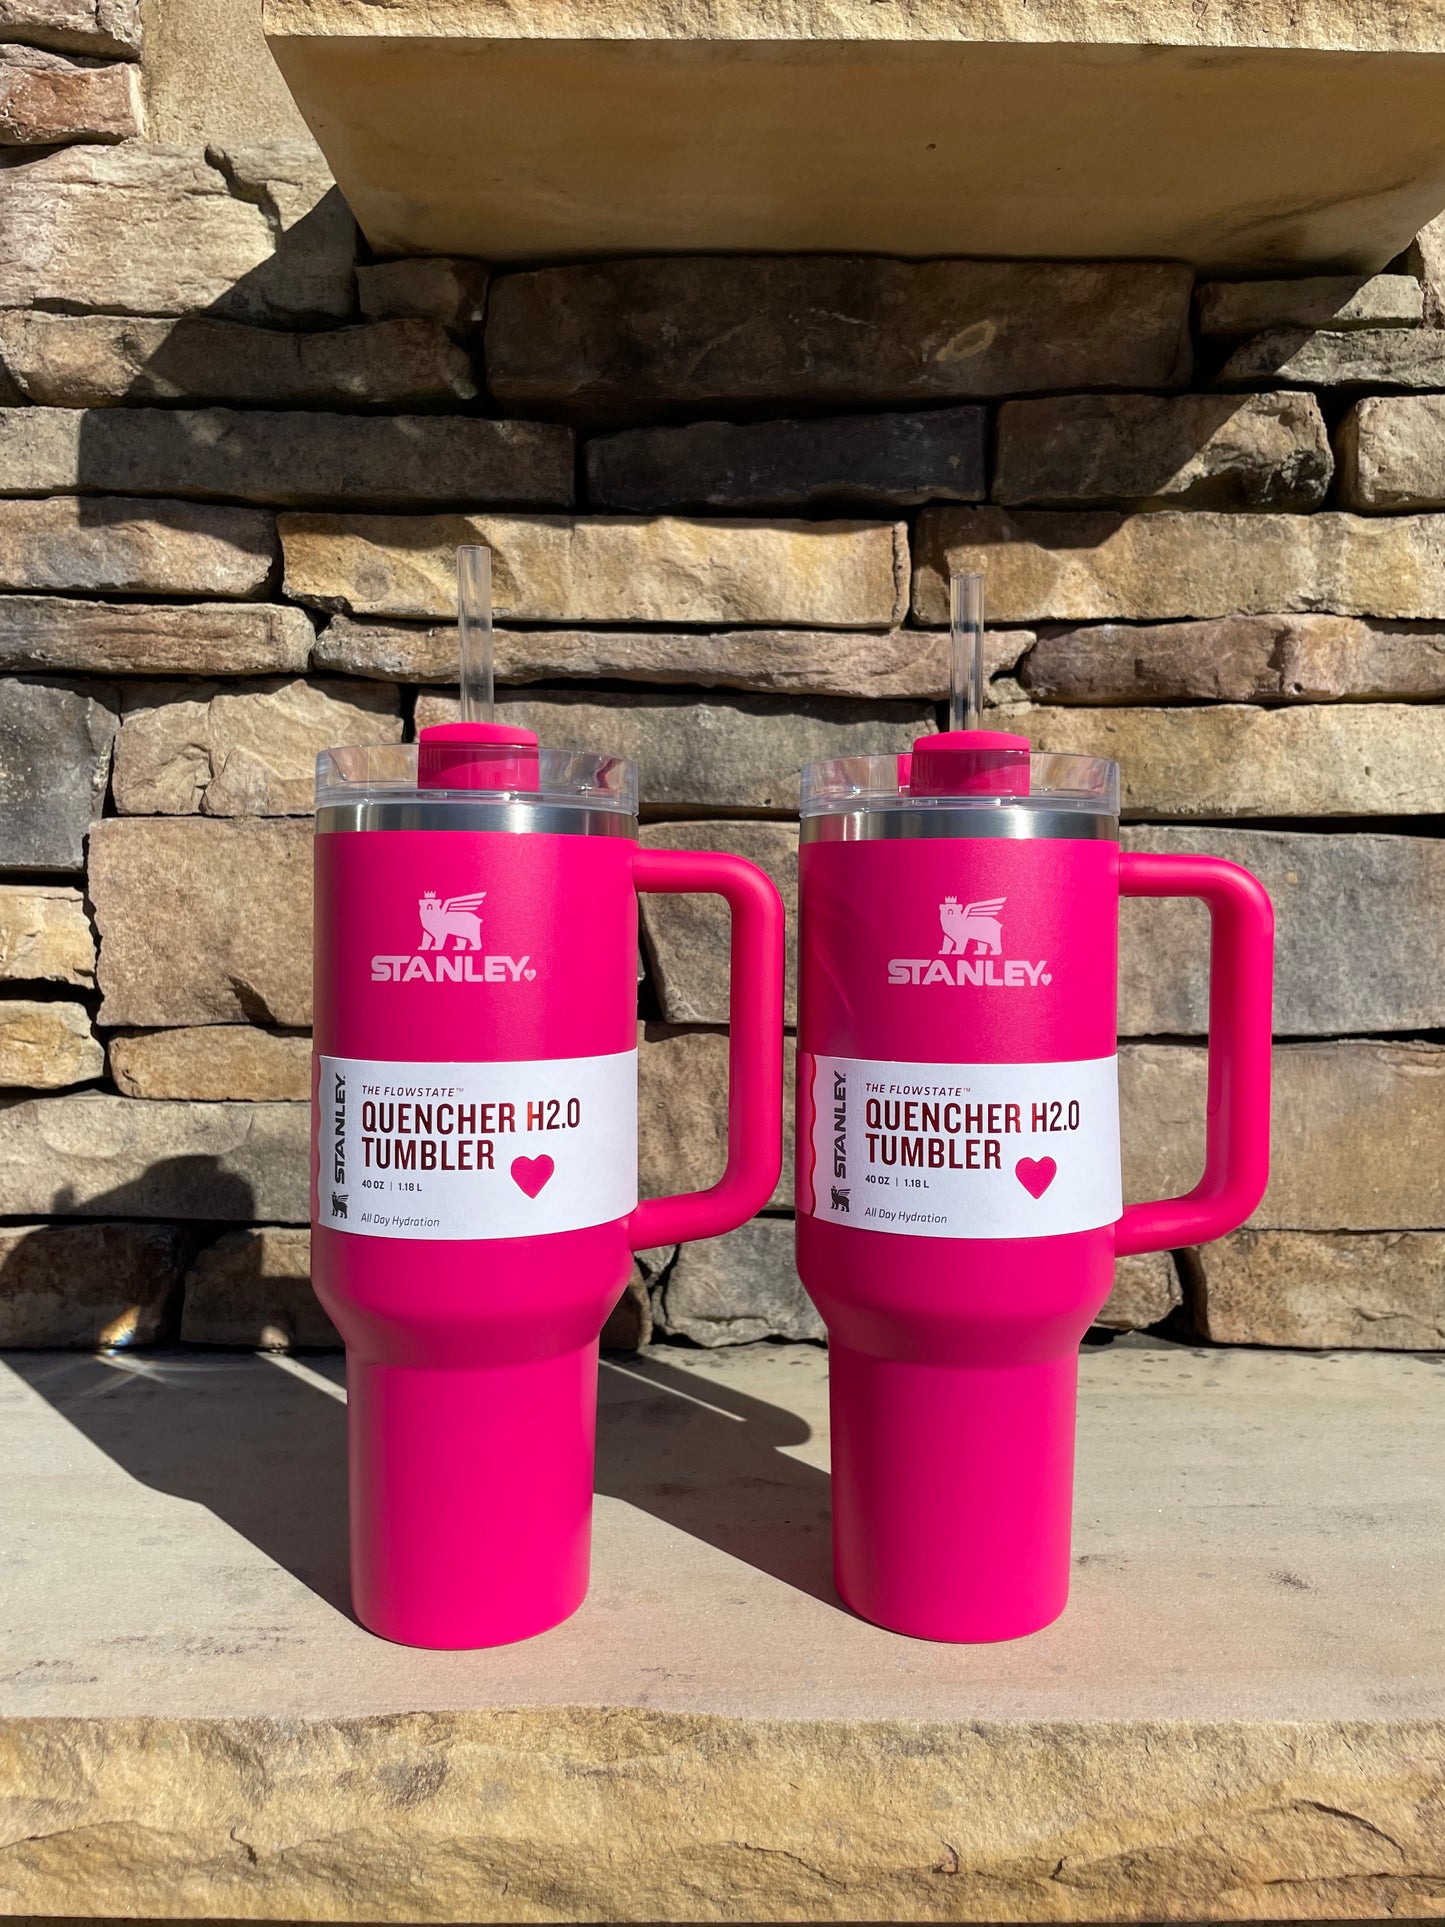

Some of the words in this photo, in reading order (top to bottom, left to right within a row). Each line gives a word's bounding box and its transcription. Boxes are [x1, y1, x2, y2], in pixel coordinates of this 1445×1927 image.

[371, 955, 530, 982] STANLEY
[888, 958, 1047, 986] STANLEY
[362, 1085, 380, 1095] THE
[865, 1083, 886, 1094] THE
[335, 1072, 346, 1184] STANLEY
[362, 1100, 516, 1134] QUENCHER
[527, 1097, 580, 1131] H2.0
[834, 1070, 846, 1179] STANLEY
[866, 1098, 1022, 1134] QUENCHER
[1032, 1100, 1080, 1133] H2.0
[361, 1137, 495, 1171] TUMBLER
[865, 1133, 1002, 1170] TUMBLER
[362, 1180, 372, 1189] 40
[373, 1181, 385, 1190] OZ
[398, 1182, 415, 1192] 1.18
[417, 1183, 423, 1192] L
[865, 1175, 877, 1185] 40
[878, 1176, 890, 1186] OZ
[904, 1178, 921, 1189] 1.18
[923, 1179, 930, 1189] L
[361, 1213, 371, 1223] All
[373, 1213, 391, 1227] Day
[392, 1215, 440, 1228] Hydration
[864, 1207, 877, 1218] All
[878, 1209, 897, 1222] Day
[898, 1211, 947, 1224] Hydration
